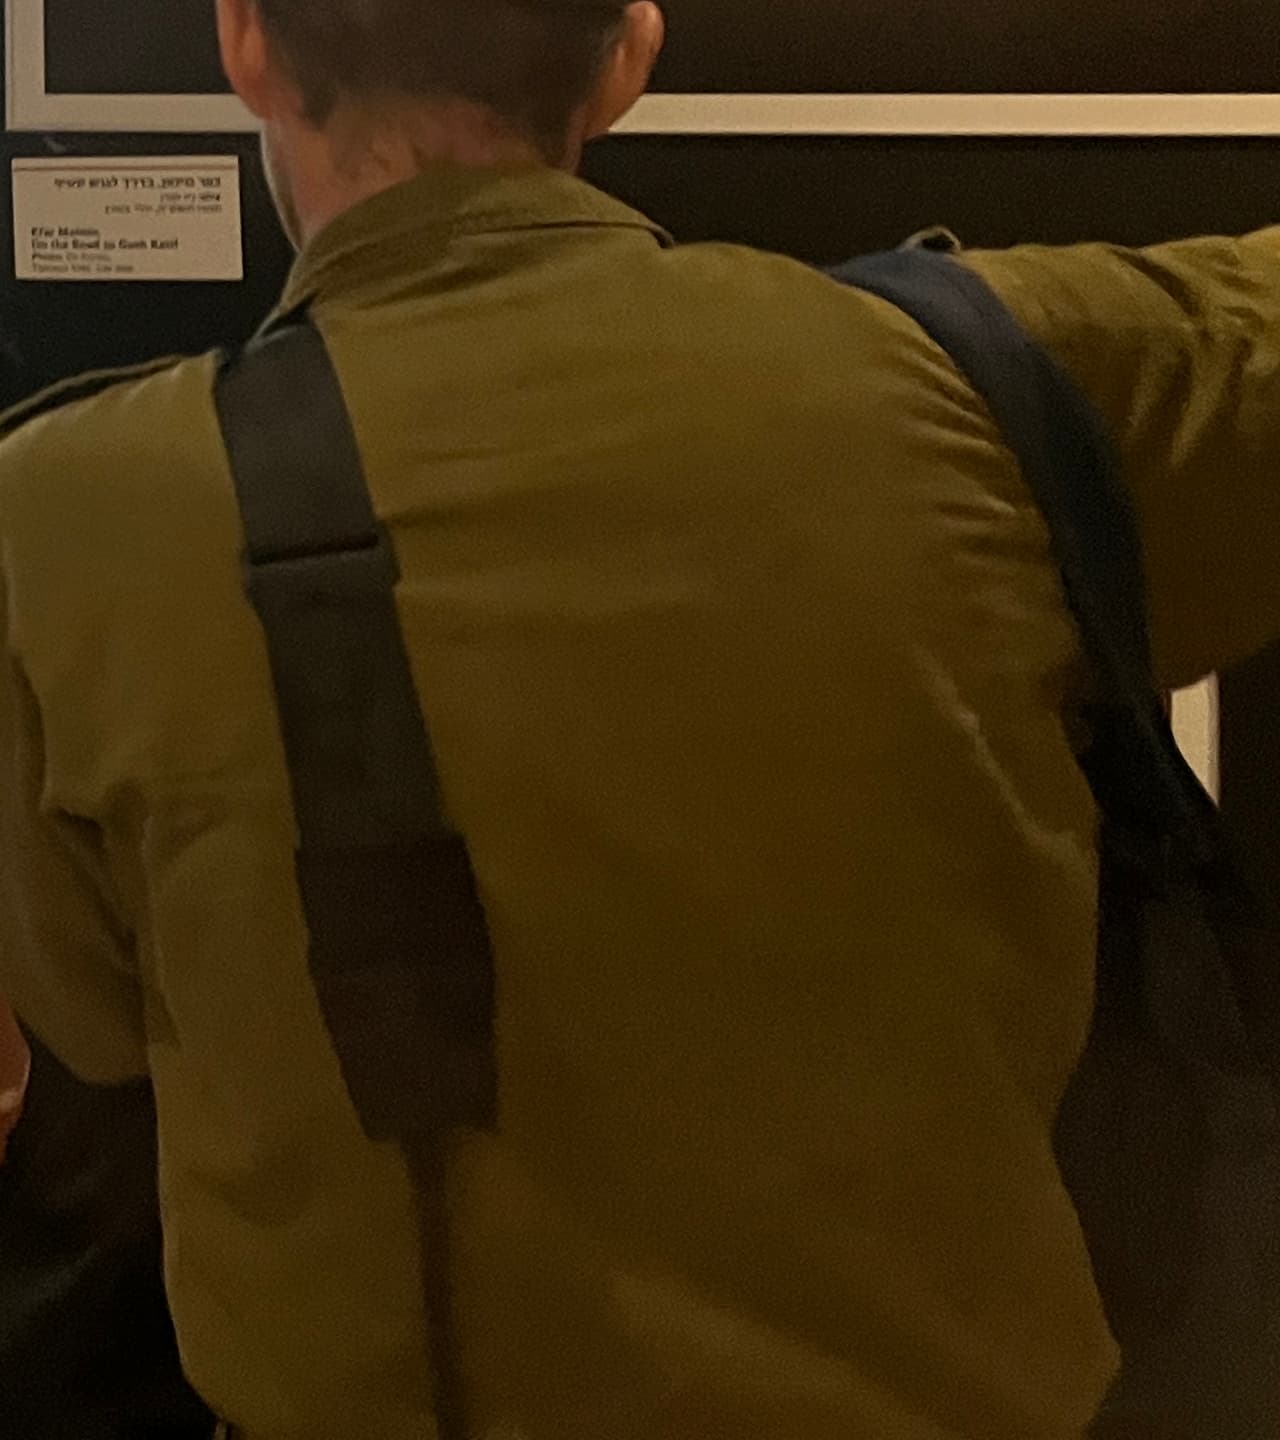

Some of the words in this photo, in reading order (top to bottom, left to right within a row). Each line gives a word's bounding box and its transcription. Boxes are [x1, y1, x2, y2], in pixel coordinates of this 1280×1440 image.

[51, 239, 68, 250] the
[72, 238, 100, 250] Road
[104, 240, 115, 250] to
